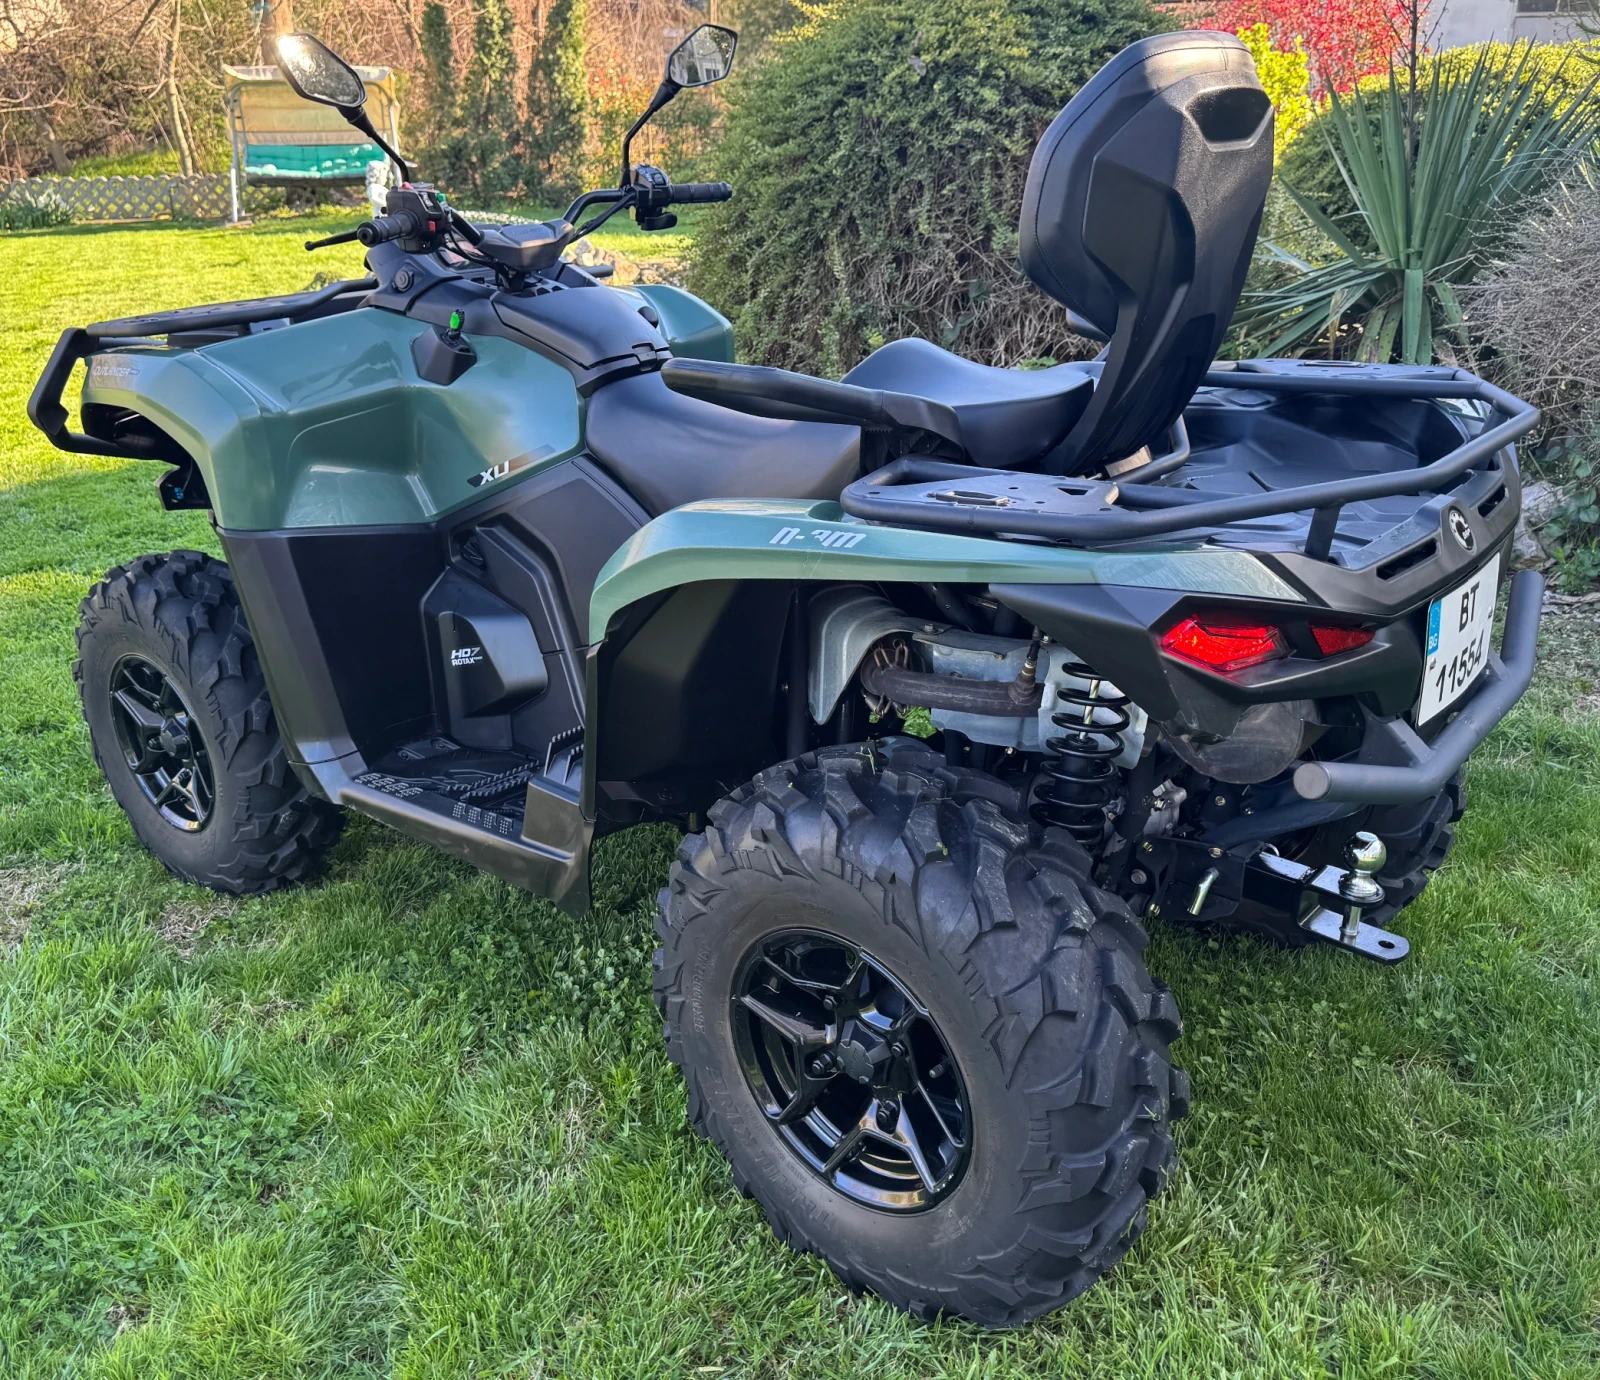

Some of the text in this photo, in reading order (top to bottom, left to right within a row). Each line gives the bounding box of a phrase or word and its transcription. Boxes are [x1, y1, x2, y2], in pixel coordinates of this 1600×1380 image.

[93, 365, 130, 377] OUTLANDER
[1458, 581, 1480, 633] BT
[1428, 632, 1439, 650] BG
[451, 646, 480, 659] HD7
[451, 656, 475, 667] ROTAX
[1436, 629, 1485, 703] 11554
